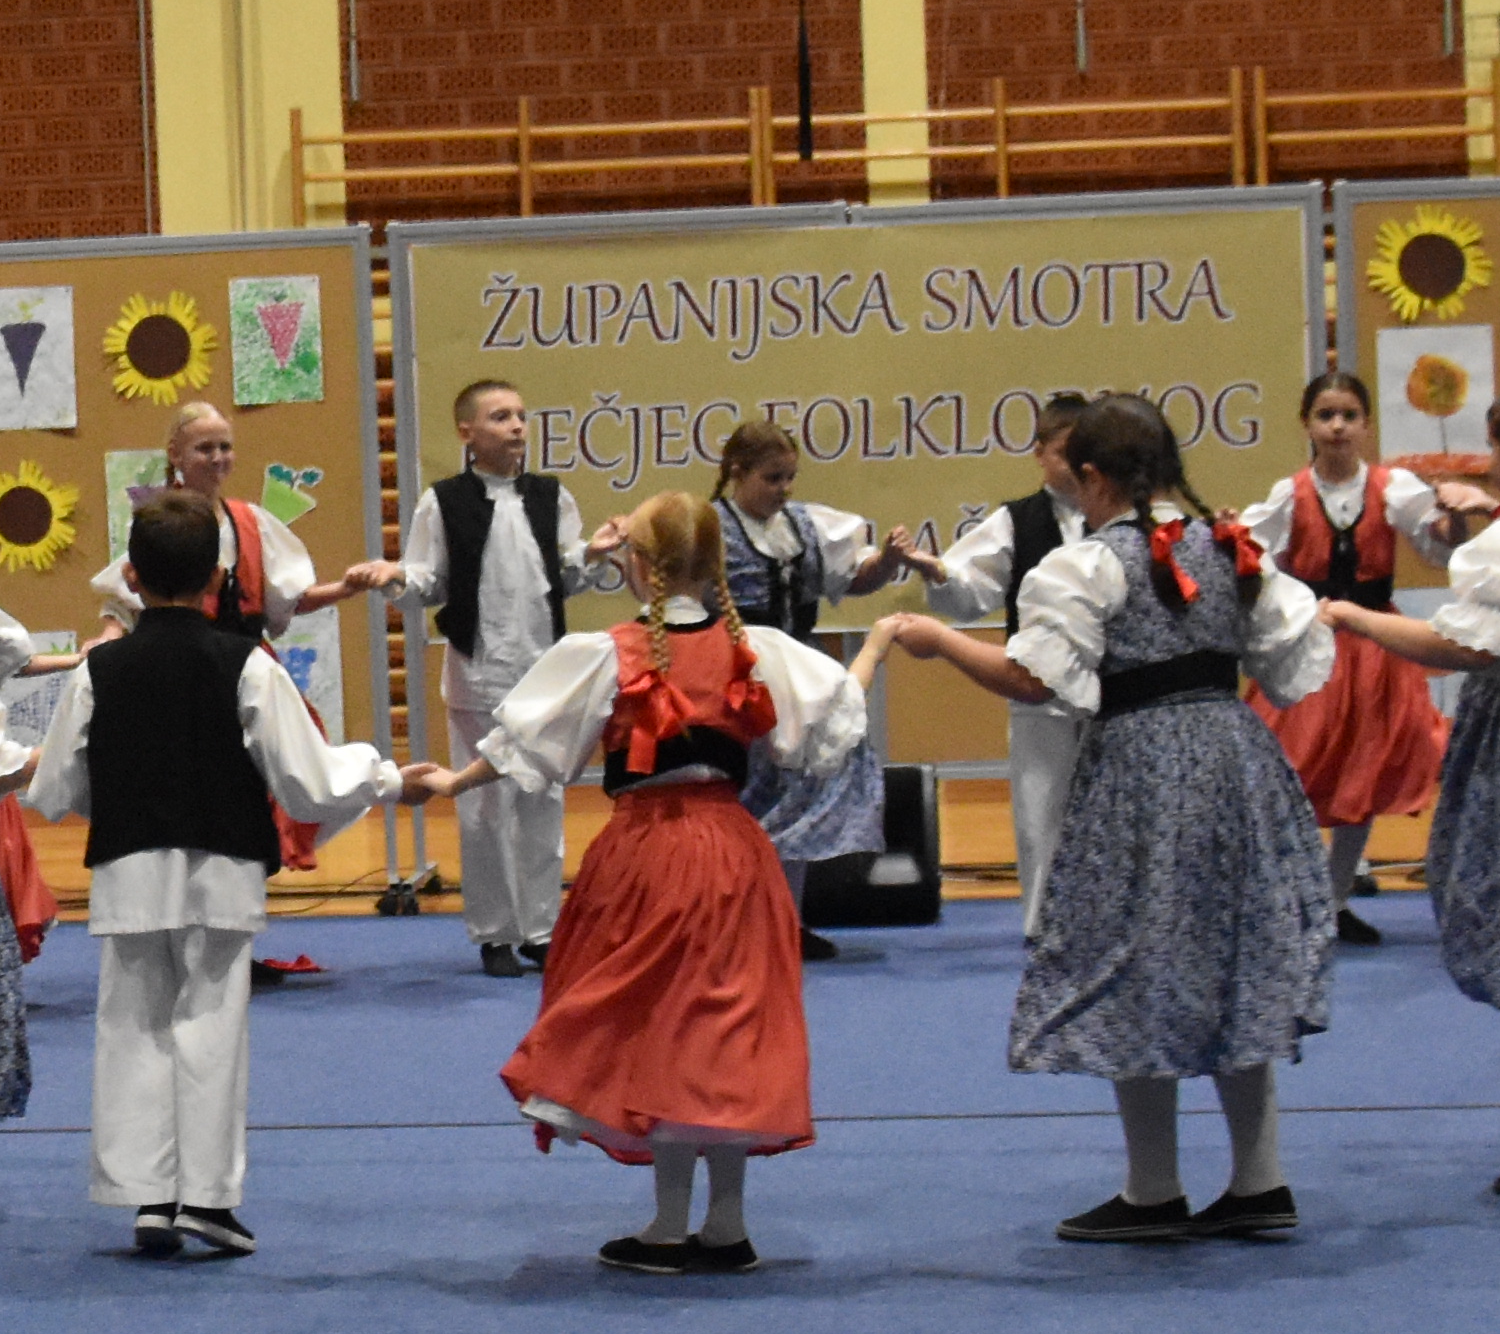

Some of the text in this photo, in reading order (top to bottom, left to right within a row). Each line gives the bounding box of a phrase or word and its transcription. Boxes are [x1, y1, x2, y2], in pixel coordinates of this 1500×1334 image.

[482, 258, 1234, 361] ŽUPANIJSKA SMOTRA
[464, 382, 1261, 491] EČJEG FOLKLOOG
